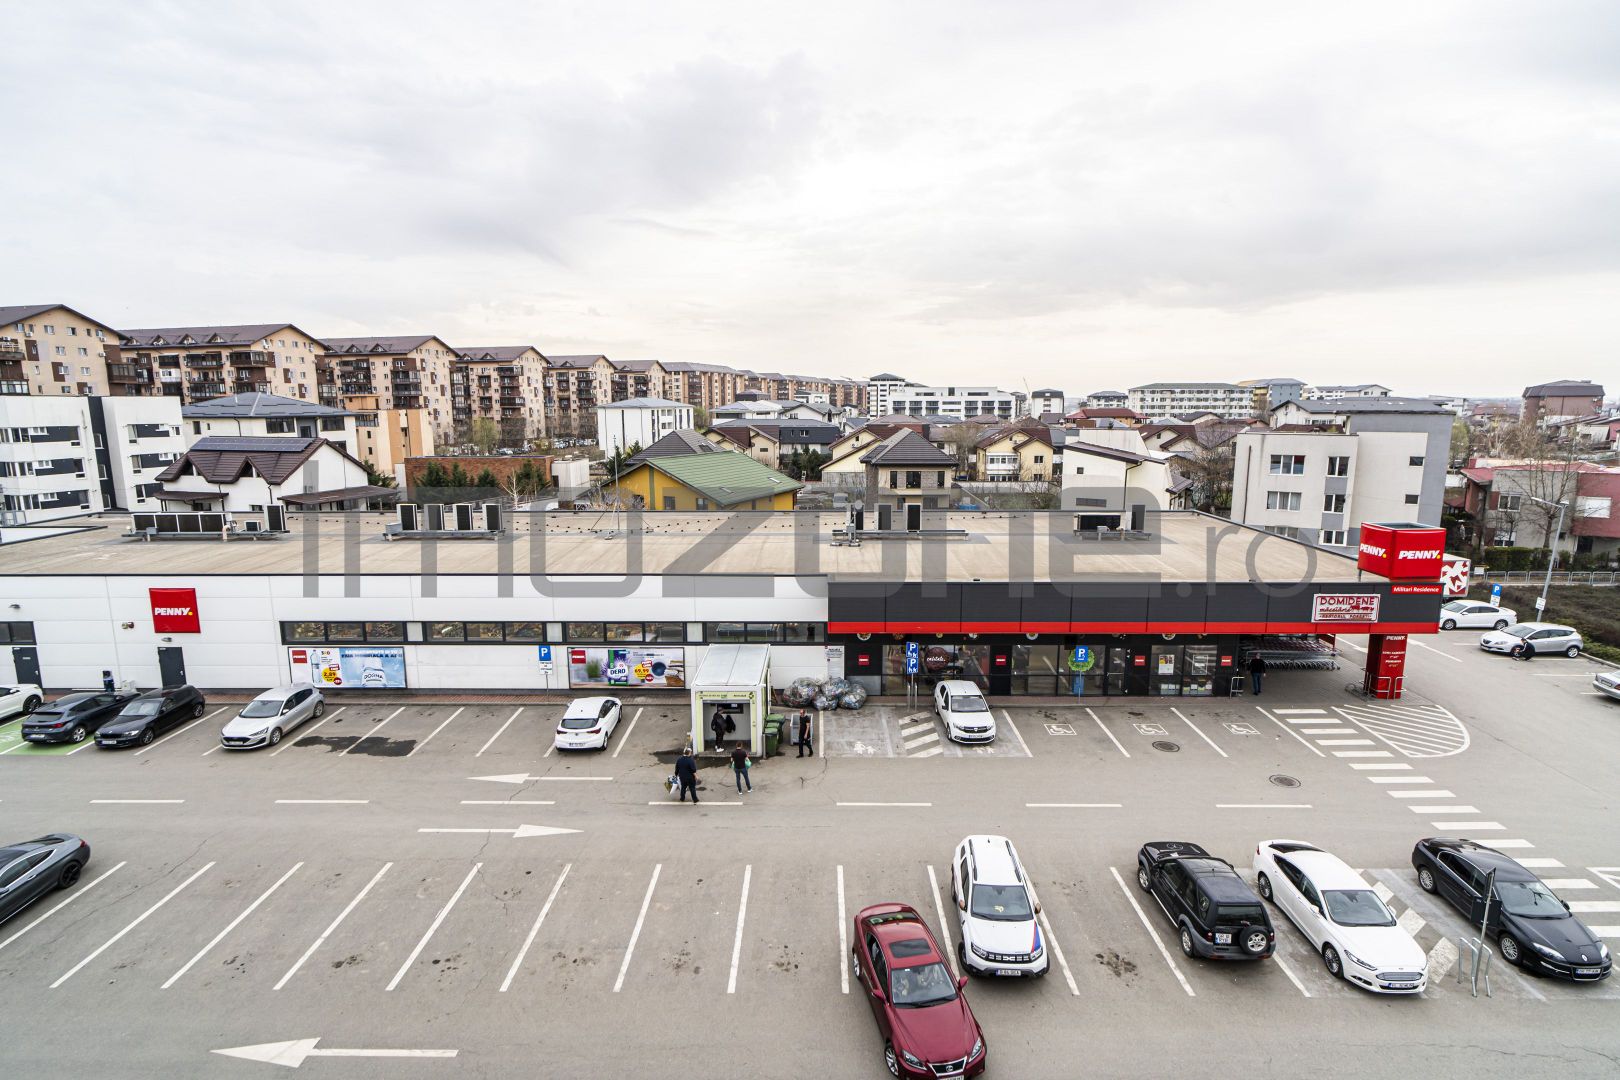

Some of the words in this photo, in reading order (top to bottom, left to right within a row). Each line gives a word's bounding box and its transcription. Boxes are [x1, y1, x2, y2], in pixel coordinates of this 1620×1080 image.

[1320, 597, 1375, 606] DOMIDENE
[910, 643, 916, 651] P
[541, 647, 548, 657] P
[1078, 648, 1086, 658] P
[910, 658, 916, 667] P
